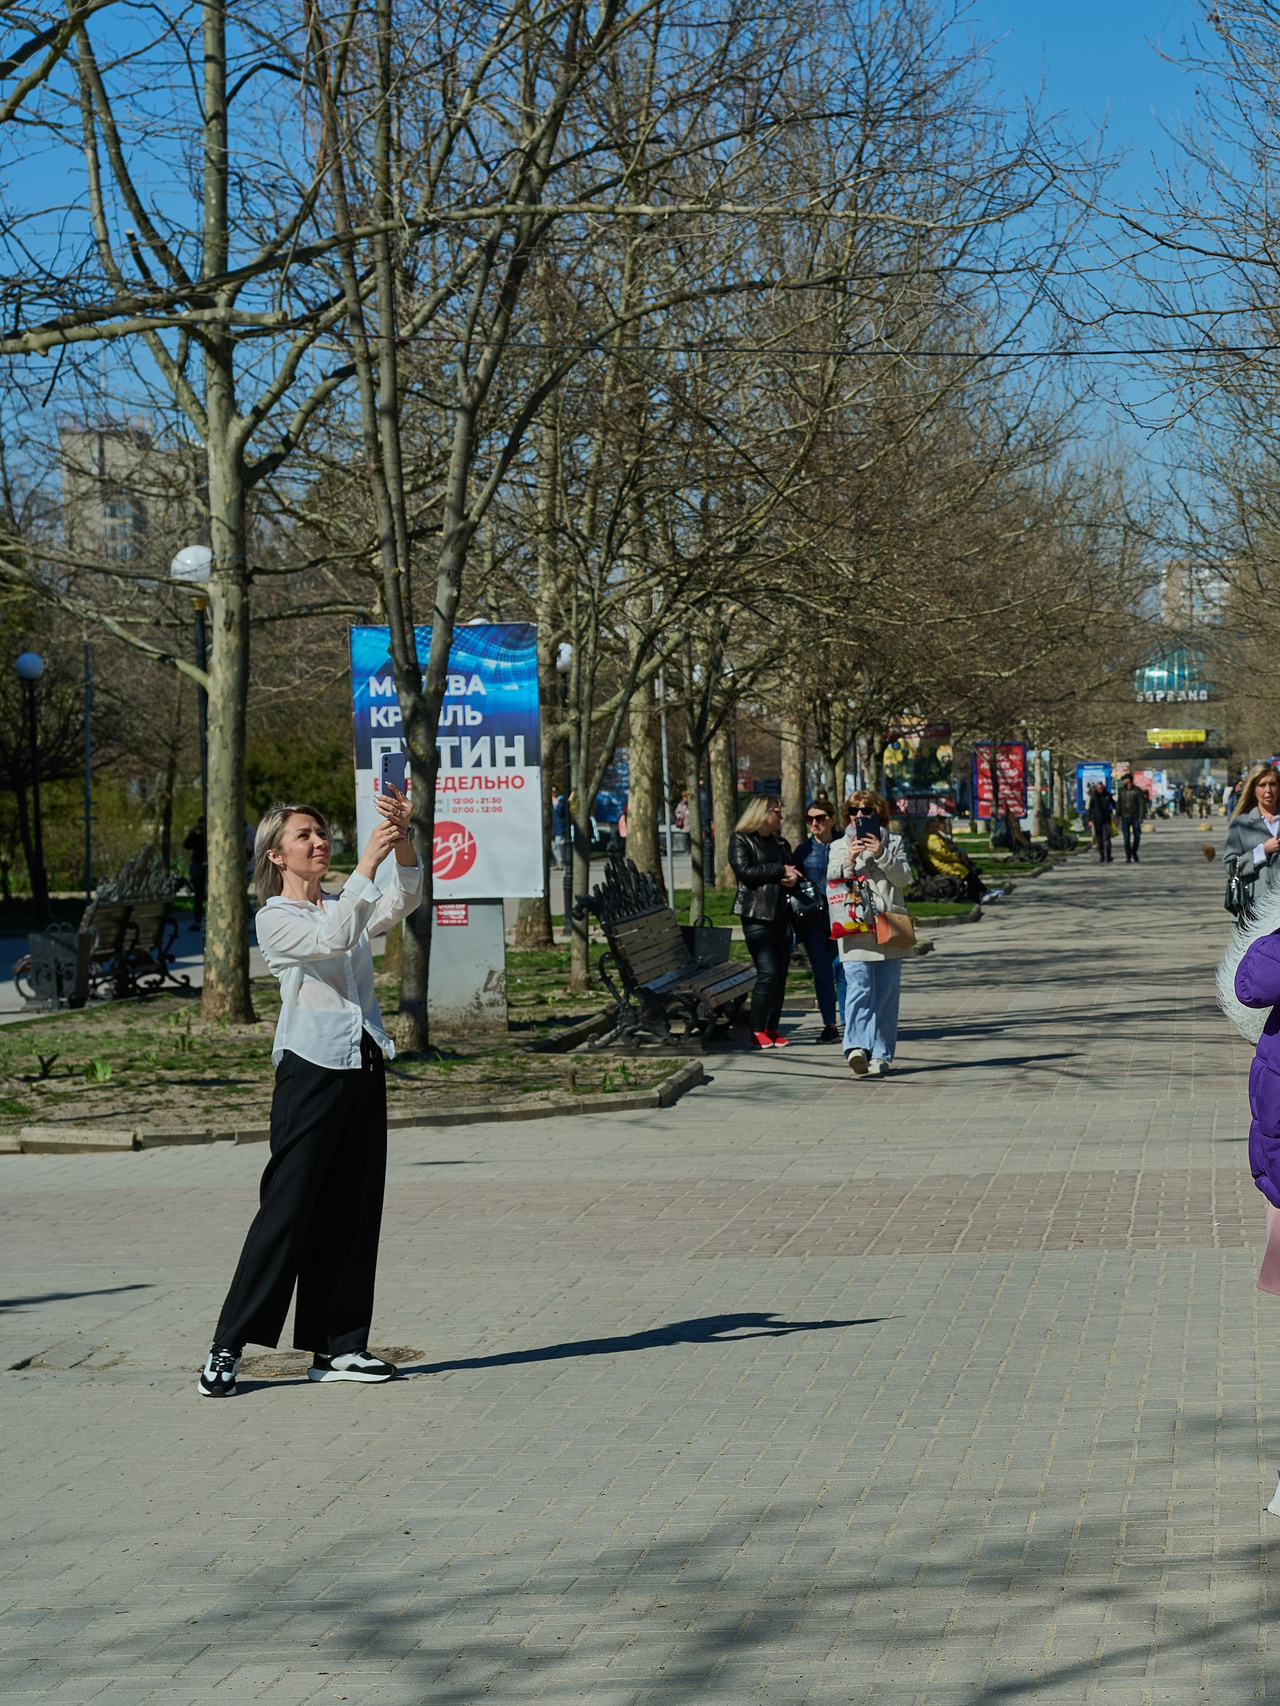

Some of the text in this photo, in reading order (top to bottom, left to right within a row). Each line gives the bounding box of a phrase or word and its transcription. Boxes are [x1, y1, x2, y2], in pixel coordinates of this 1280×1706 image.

[369, 675, 487, 697] МВА
[370, 705, 483, 727] КРЛЬ
[370, 735, 525, 769] ПТИН
